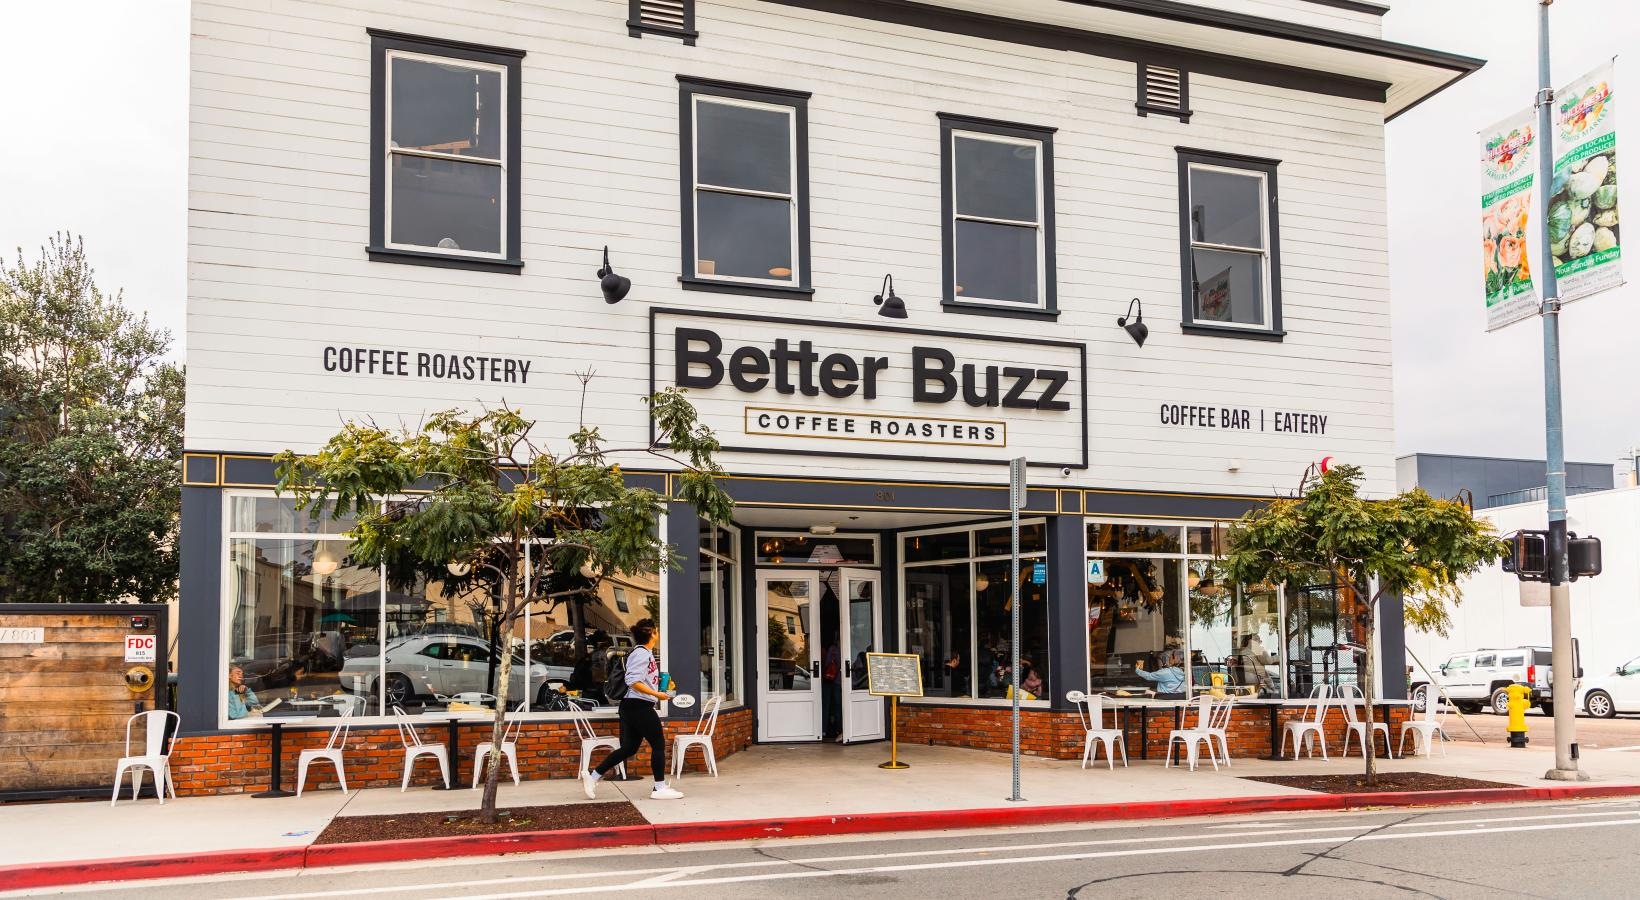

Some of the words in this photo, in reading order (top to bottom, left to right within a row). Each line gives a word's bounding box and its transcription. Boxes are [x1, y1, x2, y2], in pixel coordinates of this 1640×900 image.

[1584, 132, 1615, 149] LOCALLY
[1594, 248, 1621, 264] Funday
[324, 346, 409, 376] COFFEE
[417, 352, 531, 384] ROASTERY
[675, 327, 889, 400] Better
[912, 346, 1071, 411] Buzz
[758, 413, 856, 433] COFFEE
[870, 420, 996, 440] ROASTERS
[1160, 404, 1216, 428] COFFEE
[1221, 408, 1251, 430] BAR
[1274, 412, 1328, 435] EATERY
[1091, 562, 1100, 574] A
[128, 638, 153, 649] FDC
